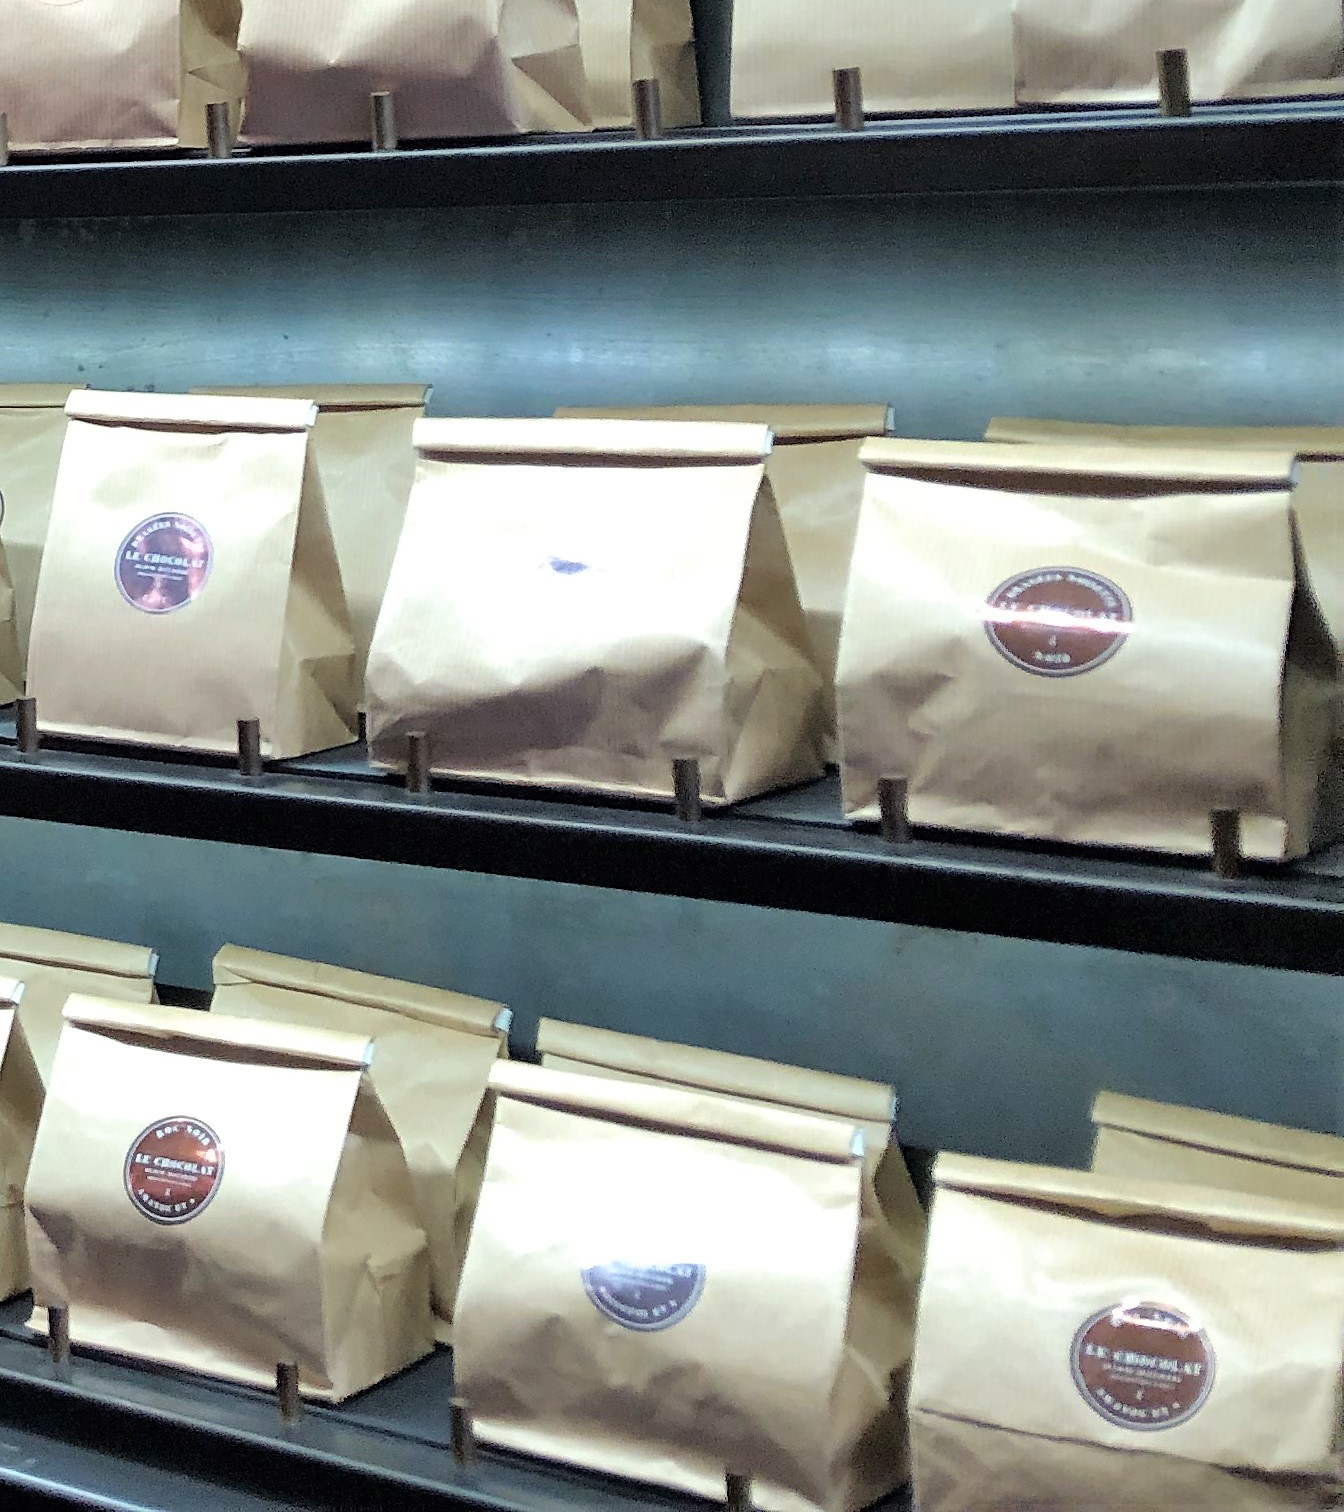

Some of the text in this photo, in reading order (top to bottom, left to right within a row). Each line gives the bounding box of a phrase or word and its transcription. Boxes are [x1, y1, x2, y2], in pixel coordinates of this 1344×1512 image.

[124, 550, 206, 569] LE CHOCOLAT
[135, 1152, 215, 1176] LE CHOCOLAT
[1085, 1343, 1203, 1377] LE CHOCOLAT
